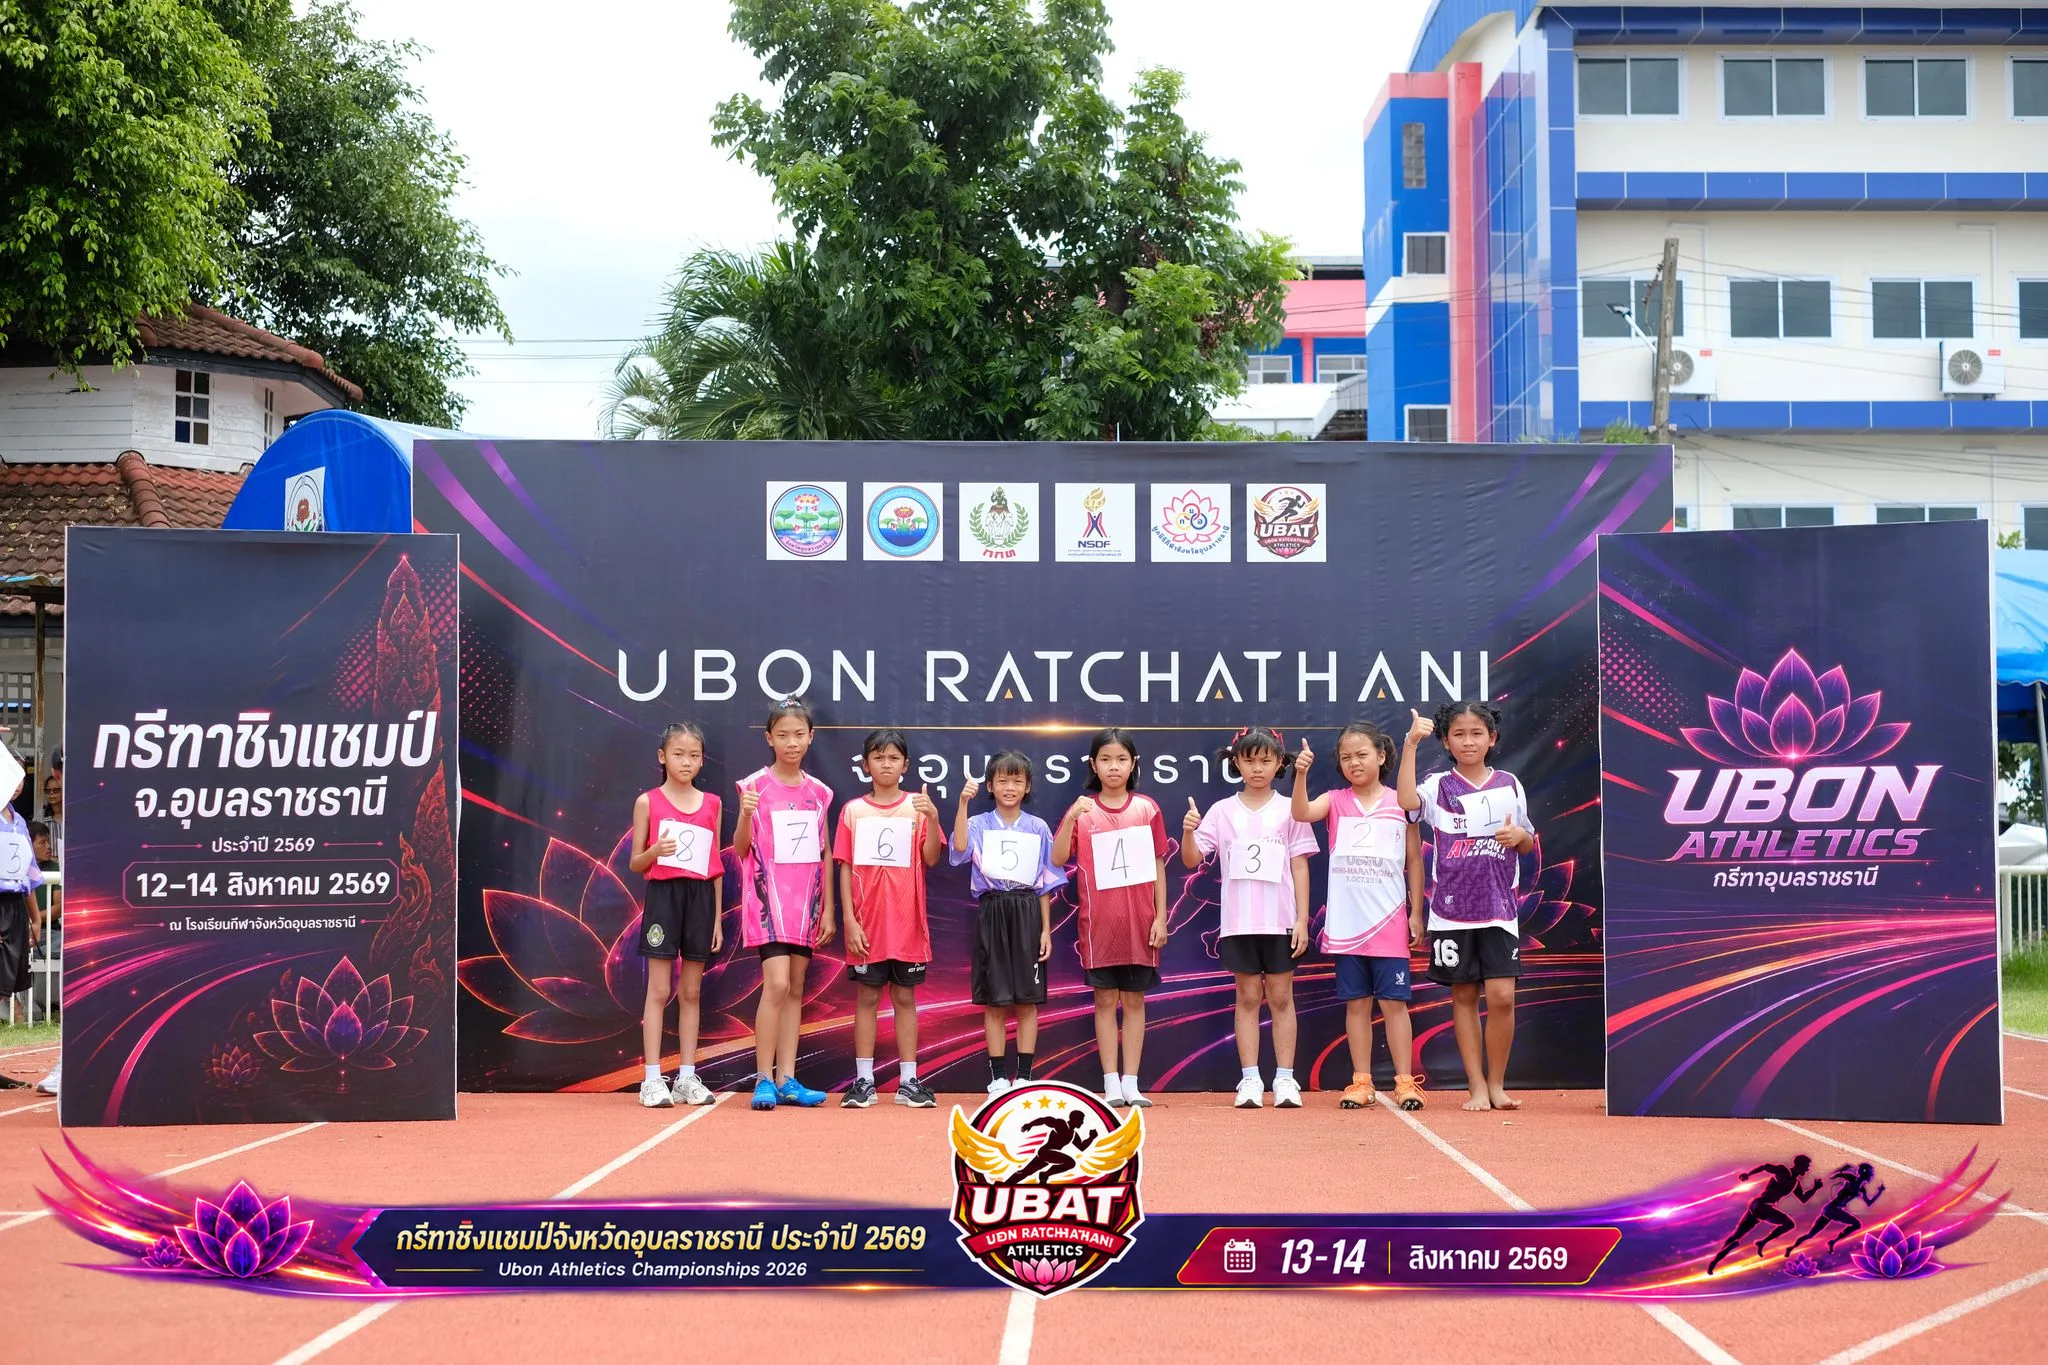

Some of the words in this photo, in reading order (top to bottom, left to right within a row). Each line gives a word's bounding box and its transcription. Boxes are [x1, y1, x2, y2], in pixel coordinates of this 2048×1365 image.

[1078, 540, 1111, 549] NSDF
[1259, 524, 1315, 538] UBAT
[618, 649, 875, 702] UBON
[926, 650, 1489, 703] RATCHATHANI
[93, 708, 438, 769] กรีฑาชิงแชมป์
[134, 775, 388, 830] จ.อุบลราชธานี
[1664, 764, 1944, 825] UBON
[1481, 795, 1502, 827] 1
[211, 836, 269, 853] ประจำปี
[274, 837, 315, 853] 2569
[675, 829, 695, 862] 8
[786, 821, 809, 856] 7
[877, 827, 894, 859] 6
[1351, 822, 1373, 848] 2
[1446, 838, 1476, 860] AT
[1660, 828, 1930, 861] ATHLETICS
[6, 842, 21, 875] 3
[1001, 840, 1019, 872] 5
[1110, 837, 1130, 879] 4
[1244, 844, 1262, 874] 3
[136, 873, 218, 898] 12-14
[227, 871, 320, 897] สิงหาคม
[329, 871, 391, 895] 2569
[1713, 865, 1880, 892] กรีฑาอุบลราชธานี
[169, 921, 182, 931] ณ
[185, 915, 357, 932] โรงเรียนกีฬาจังหวัดอุบลราชธานี
[1433, 939, 1460, 968] 16
